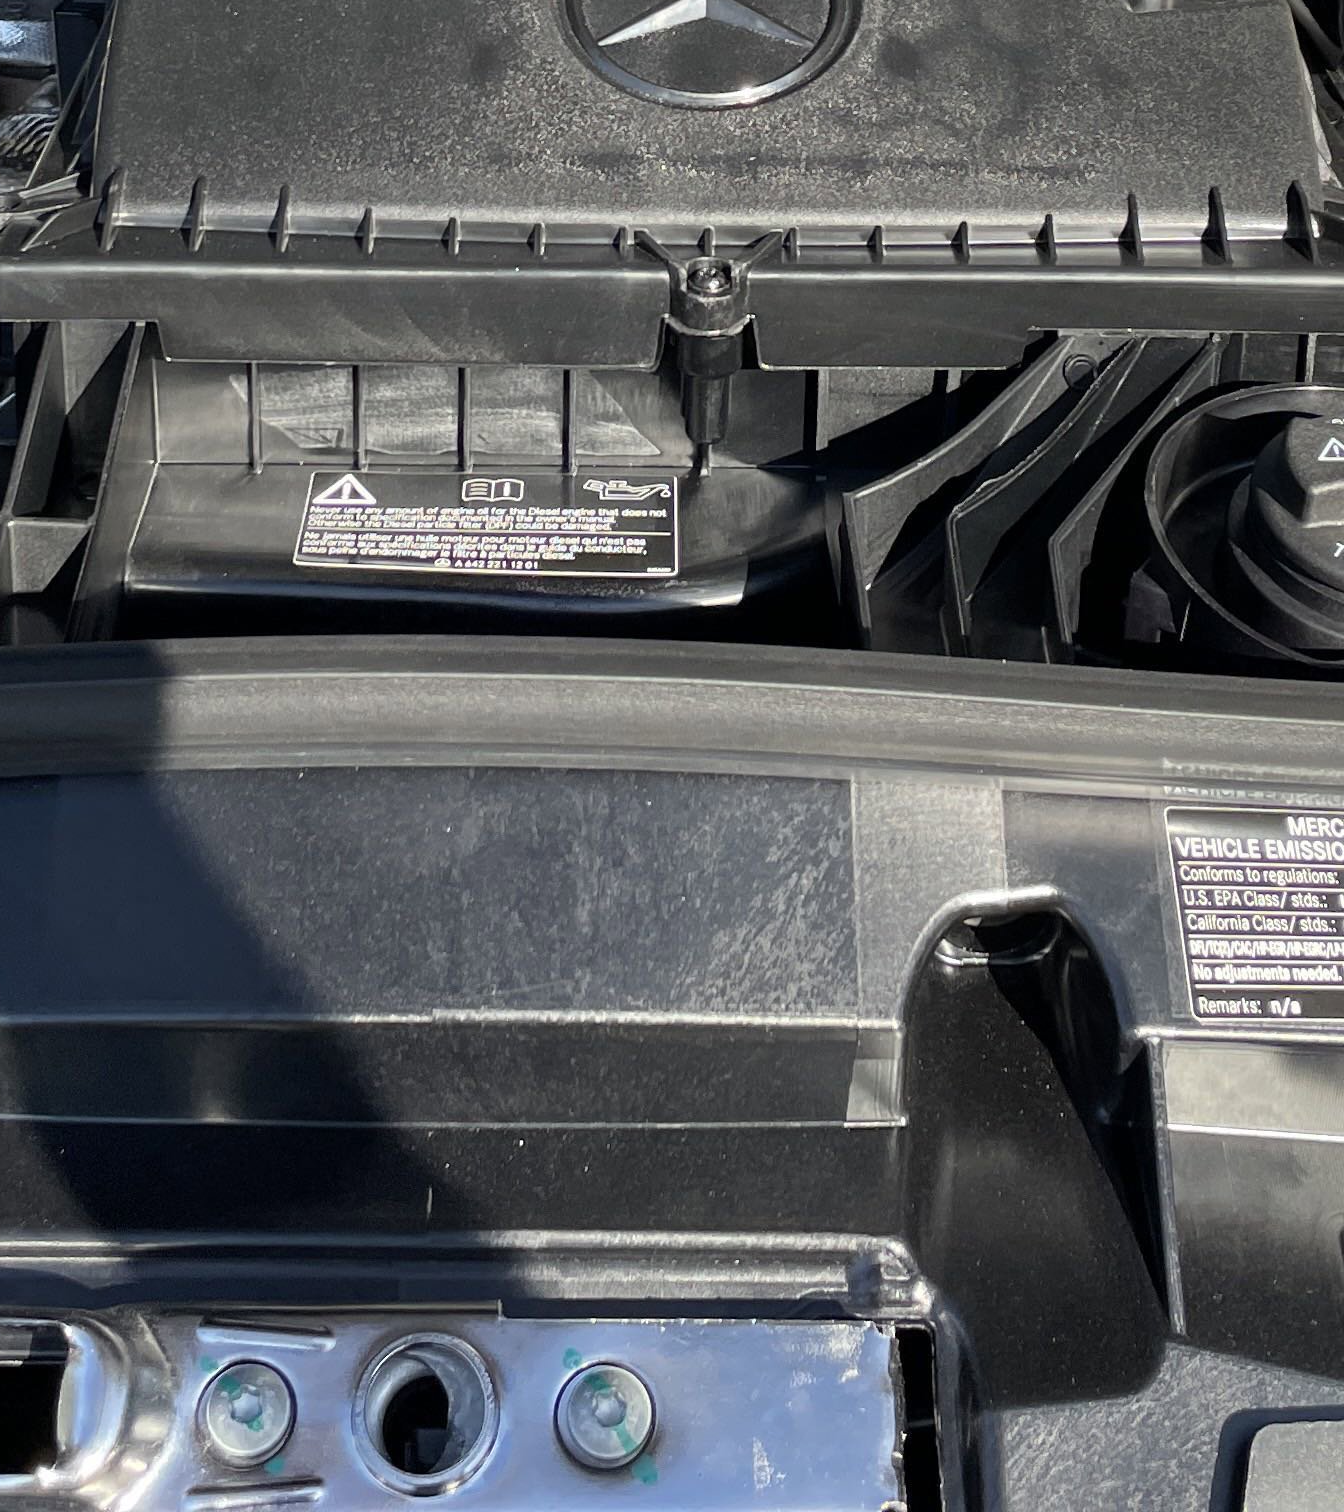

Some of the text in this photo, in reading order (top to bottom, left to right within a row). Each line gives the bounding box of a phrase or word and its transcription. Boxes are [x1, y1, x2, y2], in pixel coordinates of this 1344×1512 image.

[1175, 837, 1261, 859] VEHICLE
[1179, 864, 1244, 882] Conforms
[1245, 866, 1261, 883] to
[1263, 868, 1339, 886] regulations:
[1183, 889, 1212, 906] U.S.
[1214, 890, 1242, 907] EPA
[1243, 890, 1287, 909] Class/
[1186, 913, 1250, 931] California
[1252, 914, 1296, 933] Class/
[1192, 962, 1213, 980] No
[1214, 964, 1291, 983] adjustments
[1292, 965, 1342, 982] needed.
[1198, 996, 1301, 1017] Remarks: n/a
